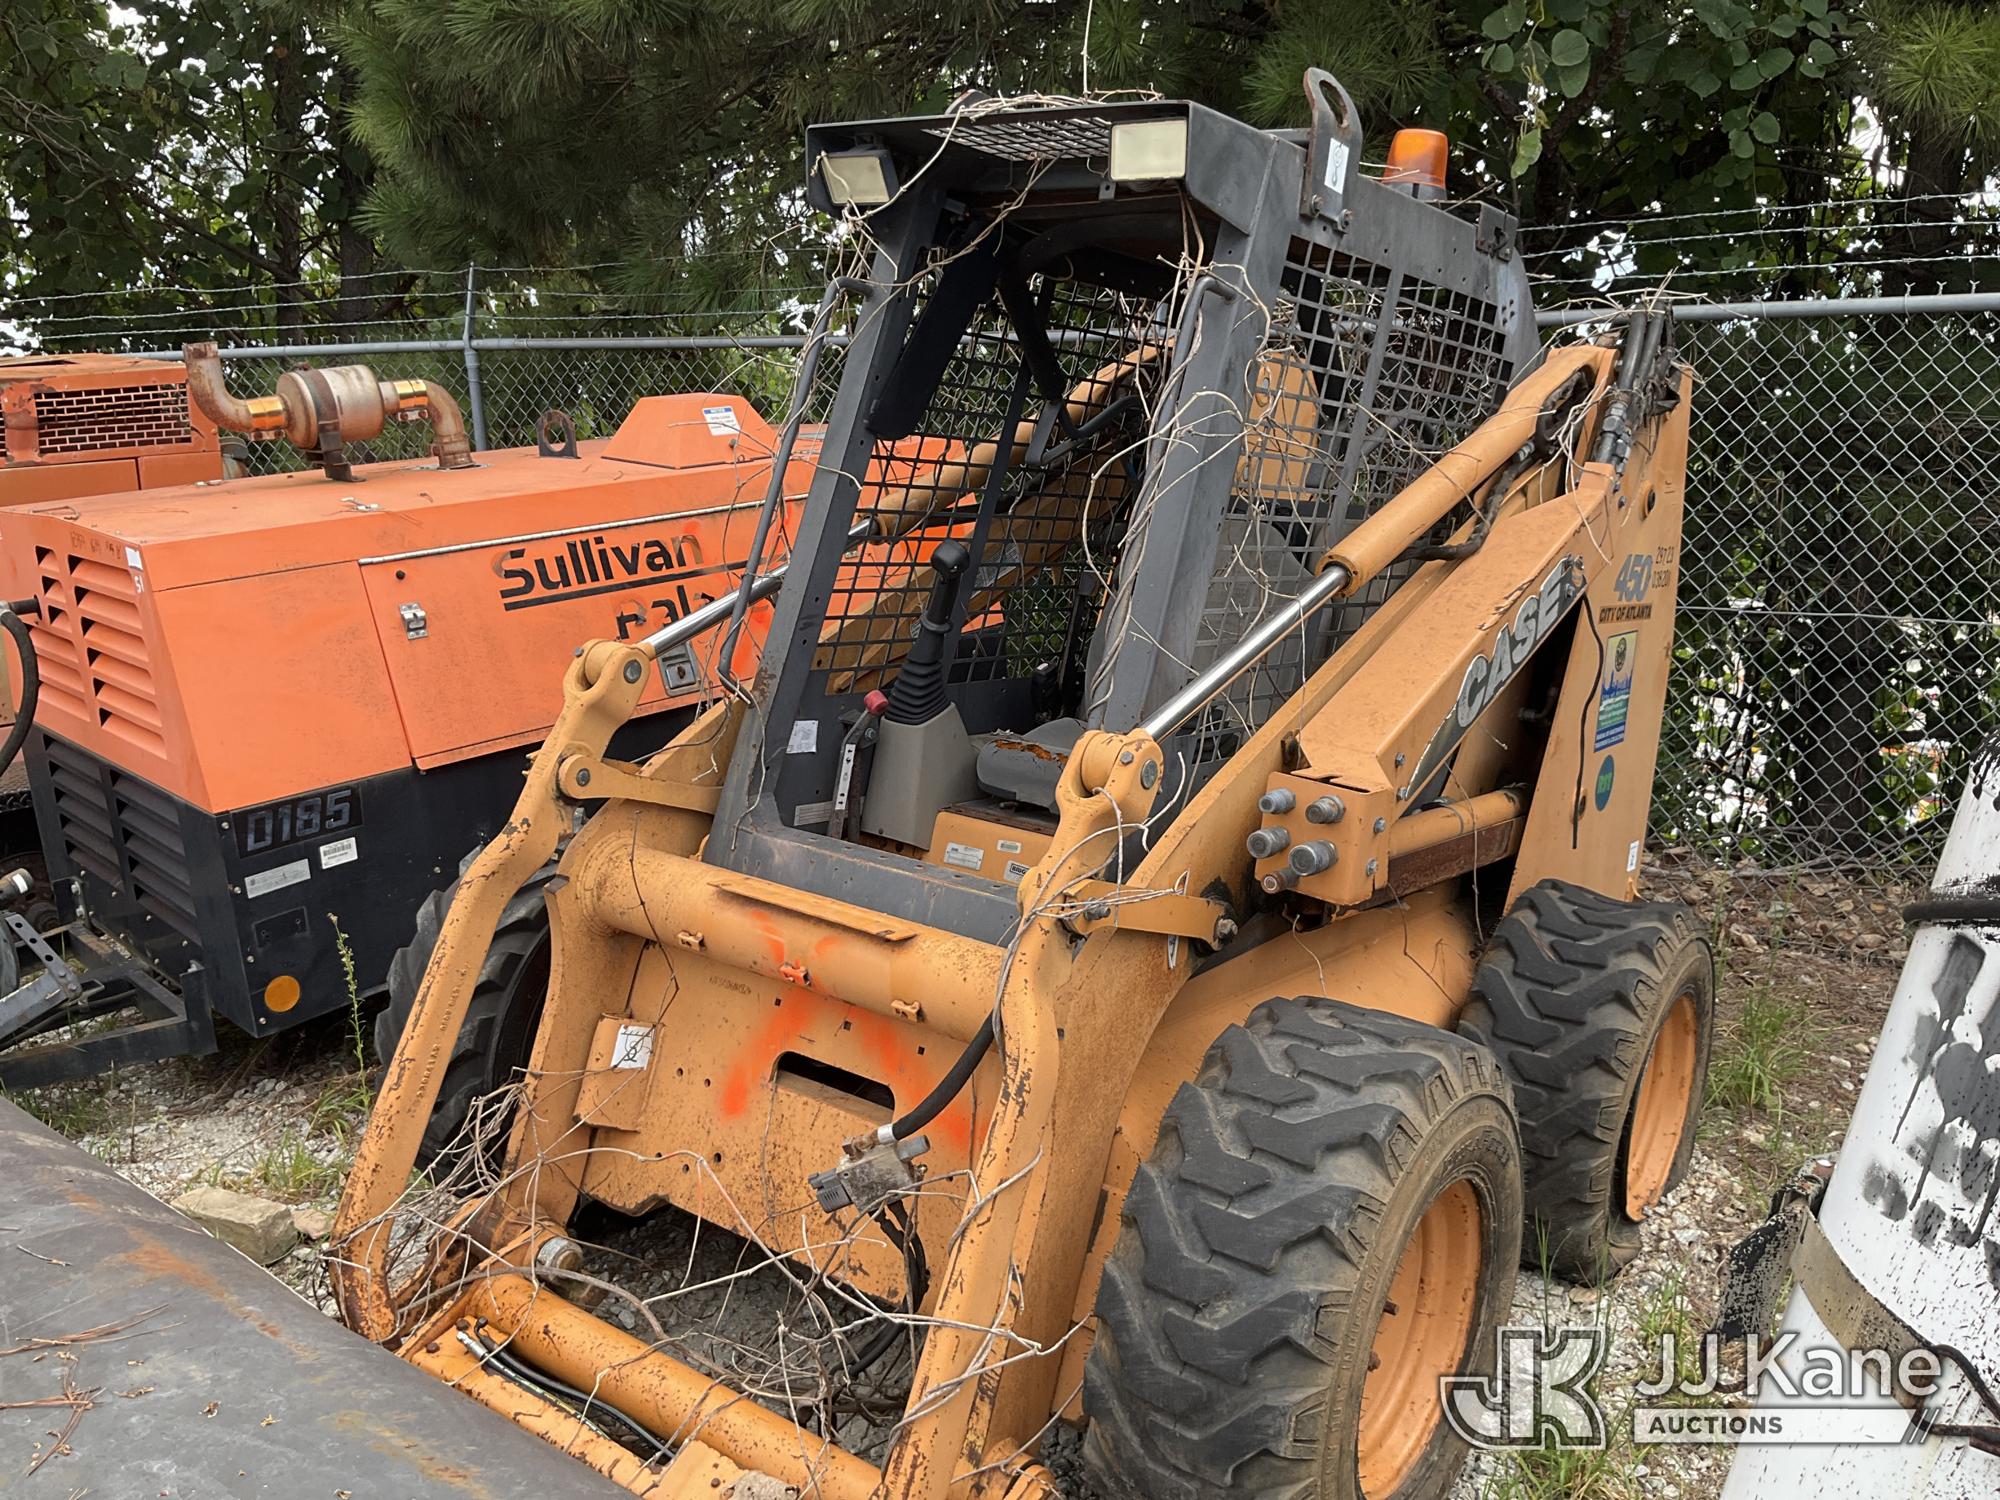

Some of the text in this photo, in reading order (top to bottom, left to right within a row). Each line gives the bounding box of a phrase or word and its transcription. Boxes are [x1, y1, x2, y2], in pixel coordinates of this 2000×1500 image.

[492, 534, 704, 599] Sullivan
[1614, 554, 1653, 602] 450
[1457, 557, 1571, 727] CASE
[1599, 604, 1652, 623] CITY OF ATLANTA
[247, 789, 352, 852] D185
